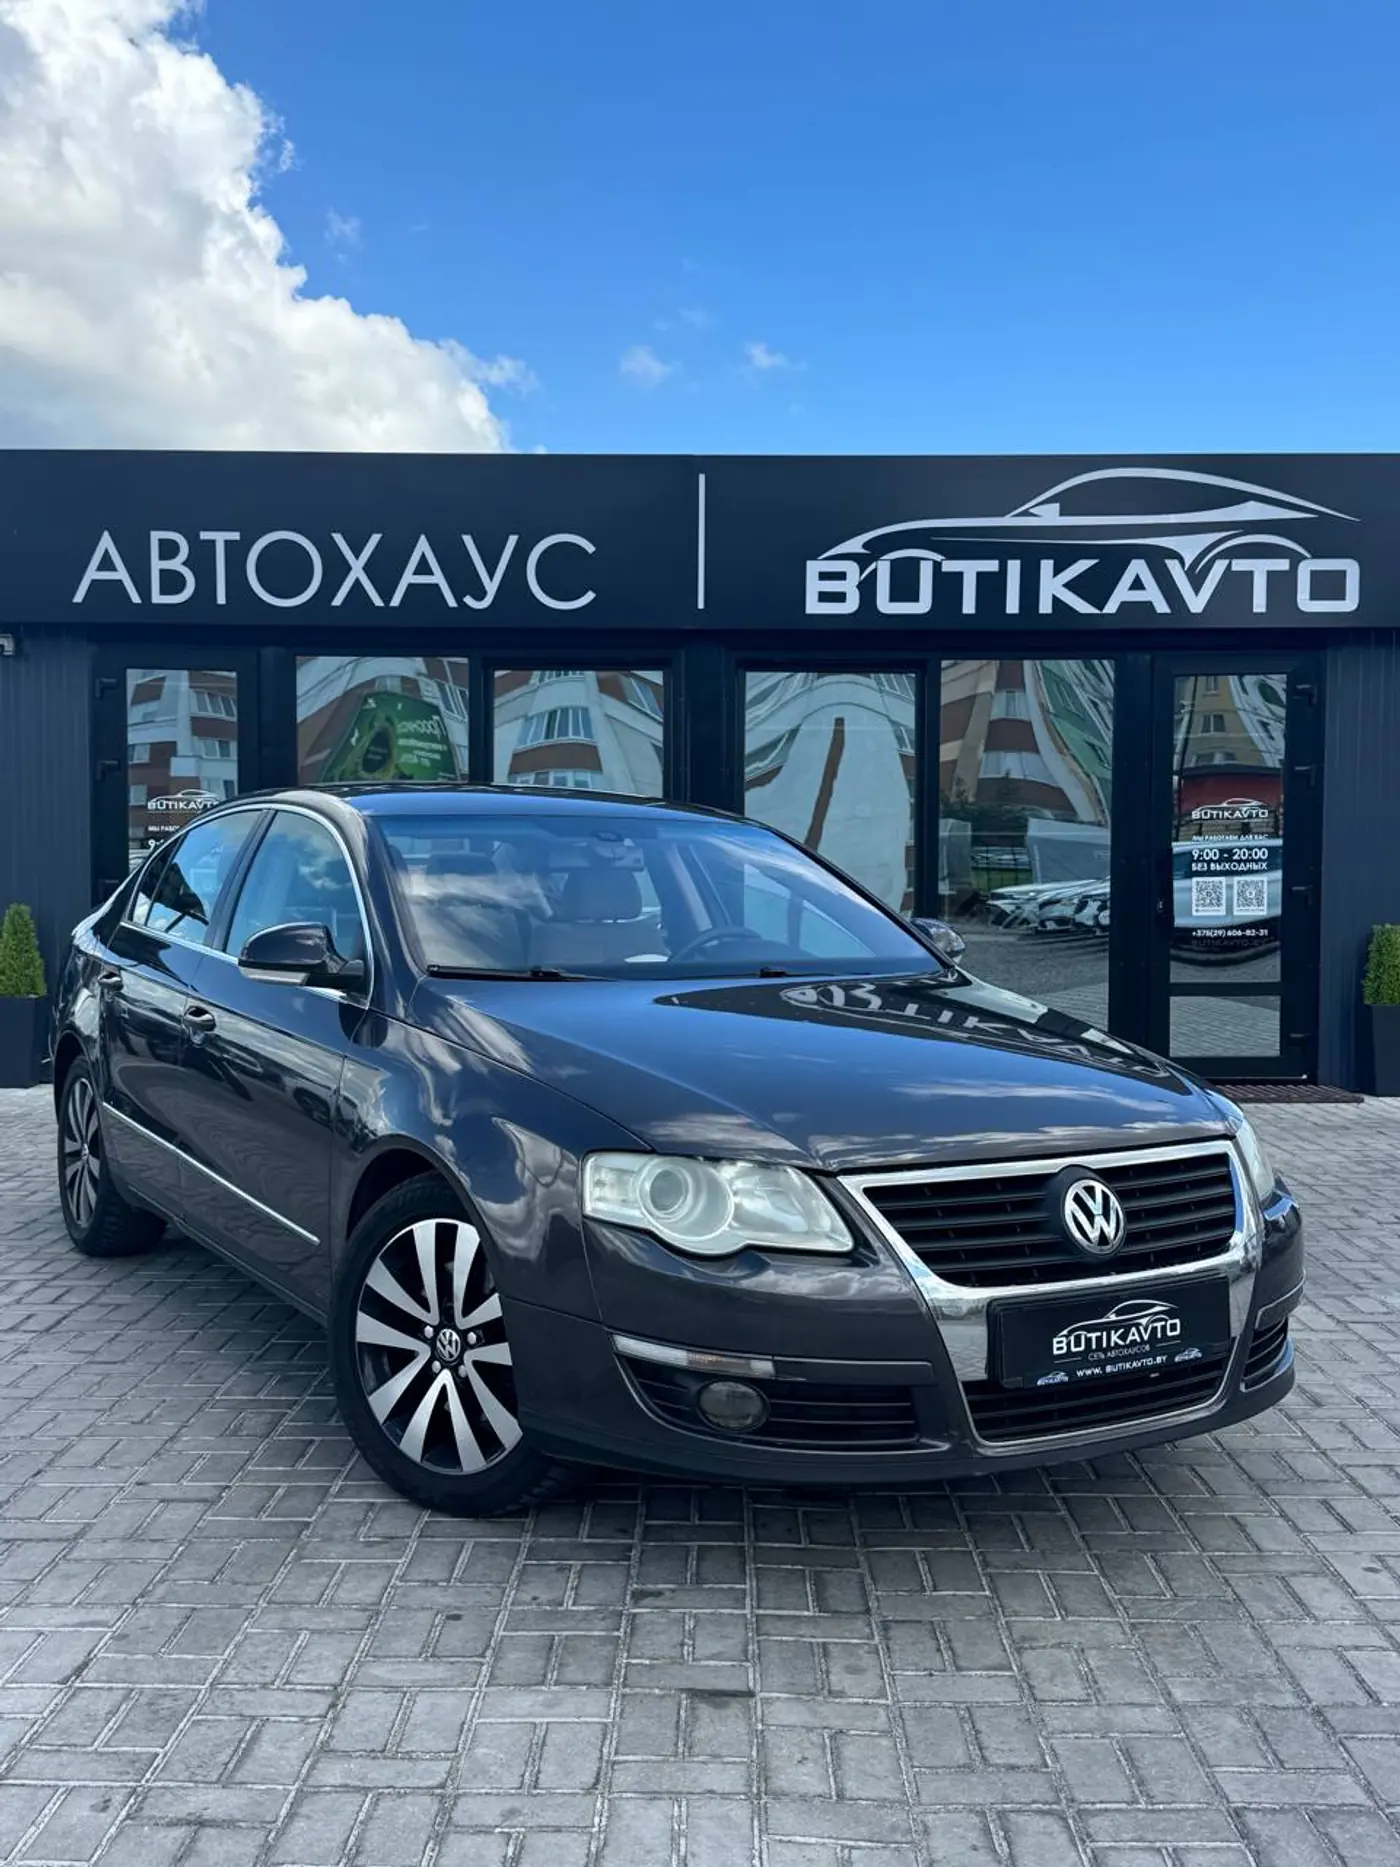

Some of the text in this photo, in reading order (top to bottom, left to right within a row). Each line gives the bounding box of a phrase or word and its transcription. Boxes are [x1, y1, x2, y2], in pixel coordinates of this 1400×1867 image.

[72, 530, 597, 610] АВТОХАУС
[805, 558, 1360, 614] BUTIKAVTO
[1191, 809, 1269, 820] BUTIKAVTO
[1192, 848, 1219, 860] 9:00
[1232, 848, 1269, 860] 20:00
[1191, 861, 1268, 872] БЕЗ ВЫХОДНЫХ
[1053, 1319, 1181, 1355] BUTIKAVTO
